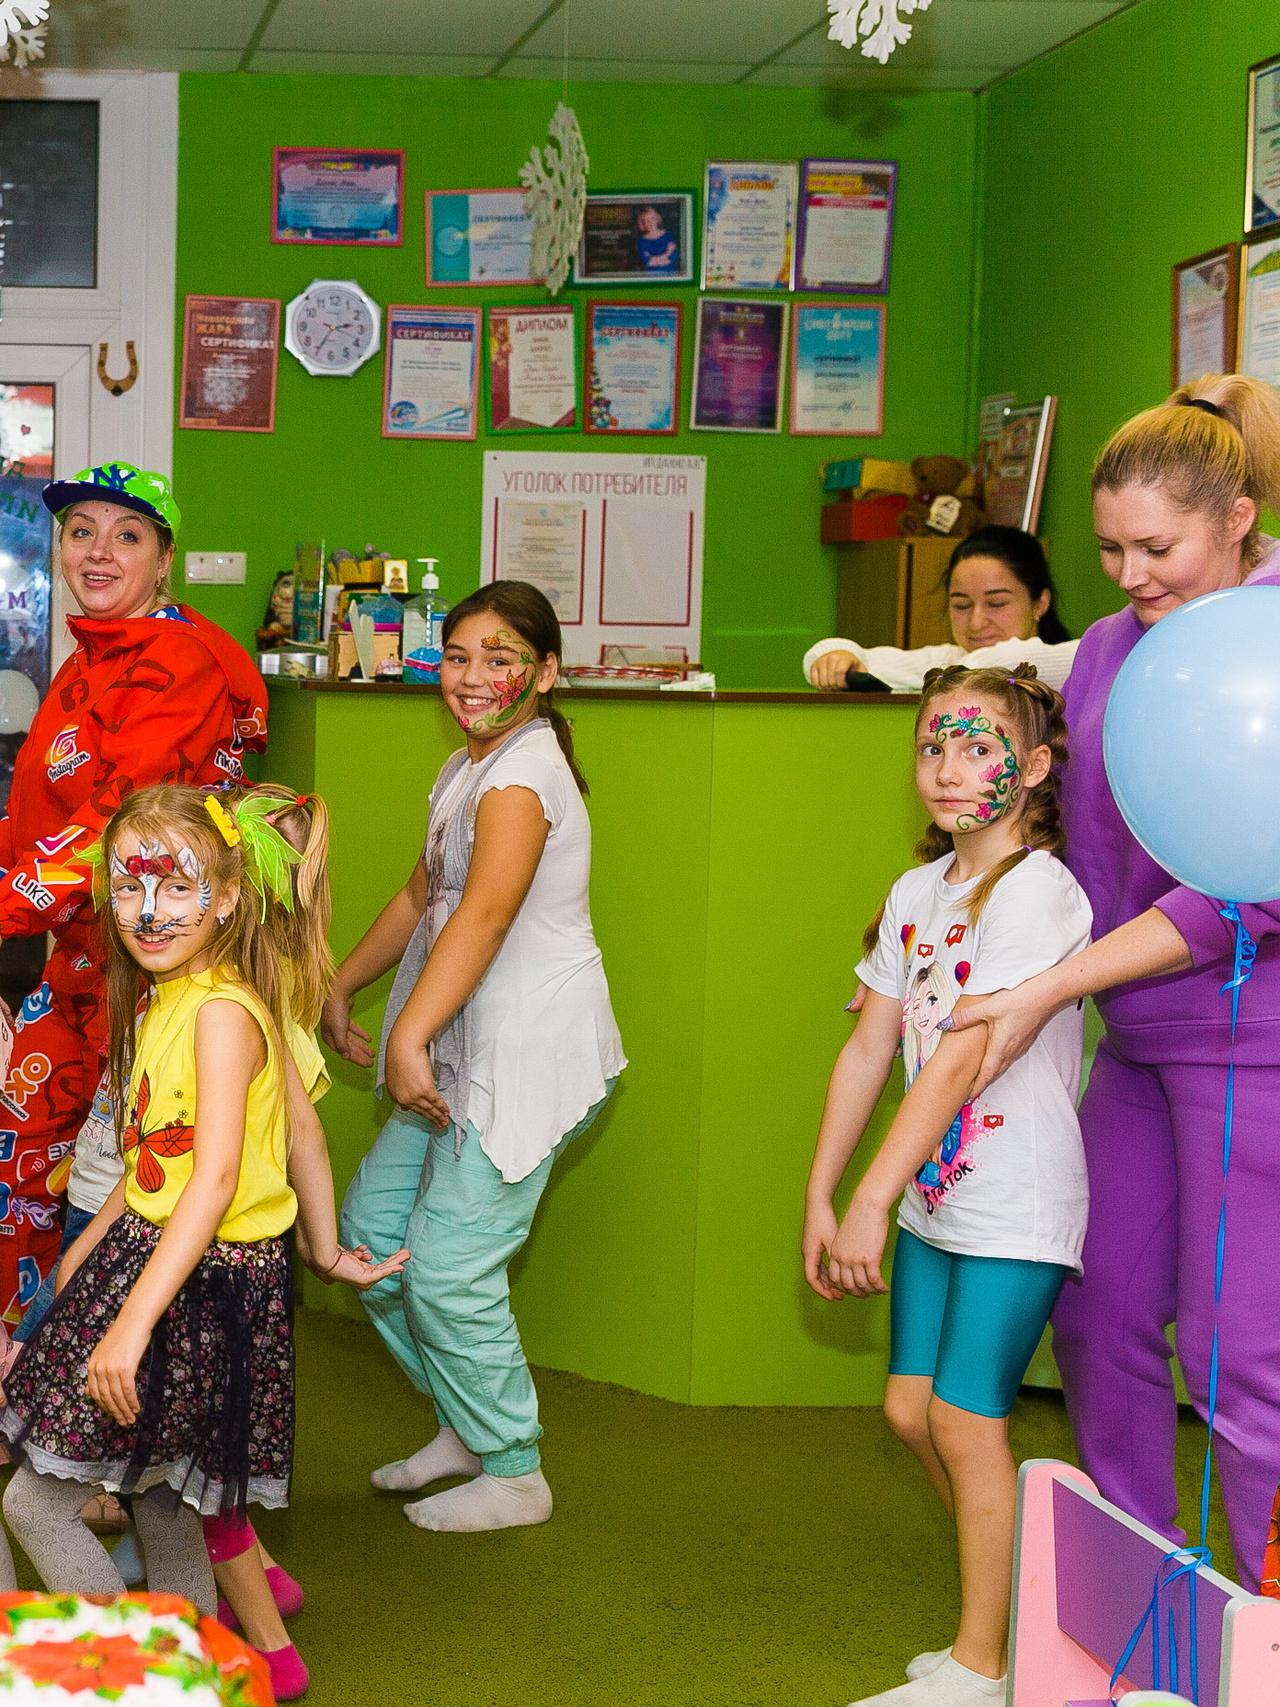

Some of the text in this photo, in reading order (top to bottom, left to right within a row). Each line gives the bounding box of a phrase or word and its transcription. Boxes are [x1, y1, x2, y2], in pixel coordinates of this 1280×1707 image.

[395, 328, 469, 340] СЕРТИФИКАТ
[515, 318, 568, 333] ДИПЛОМ
[503, 471, 688, 496] УГОЛОК ПОТРЕБИТЕЛЯ
[49, 752, 90, 782] Instagram
[15, 874, 53, 909] LIKE
